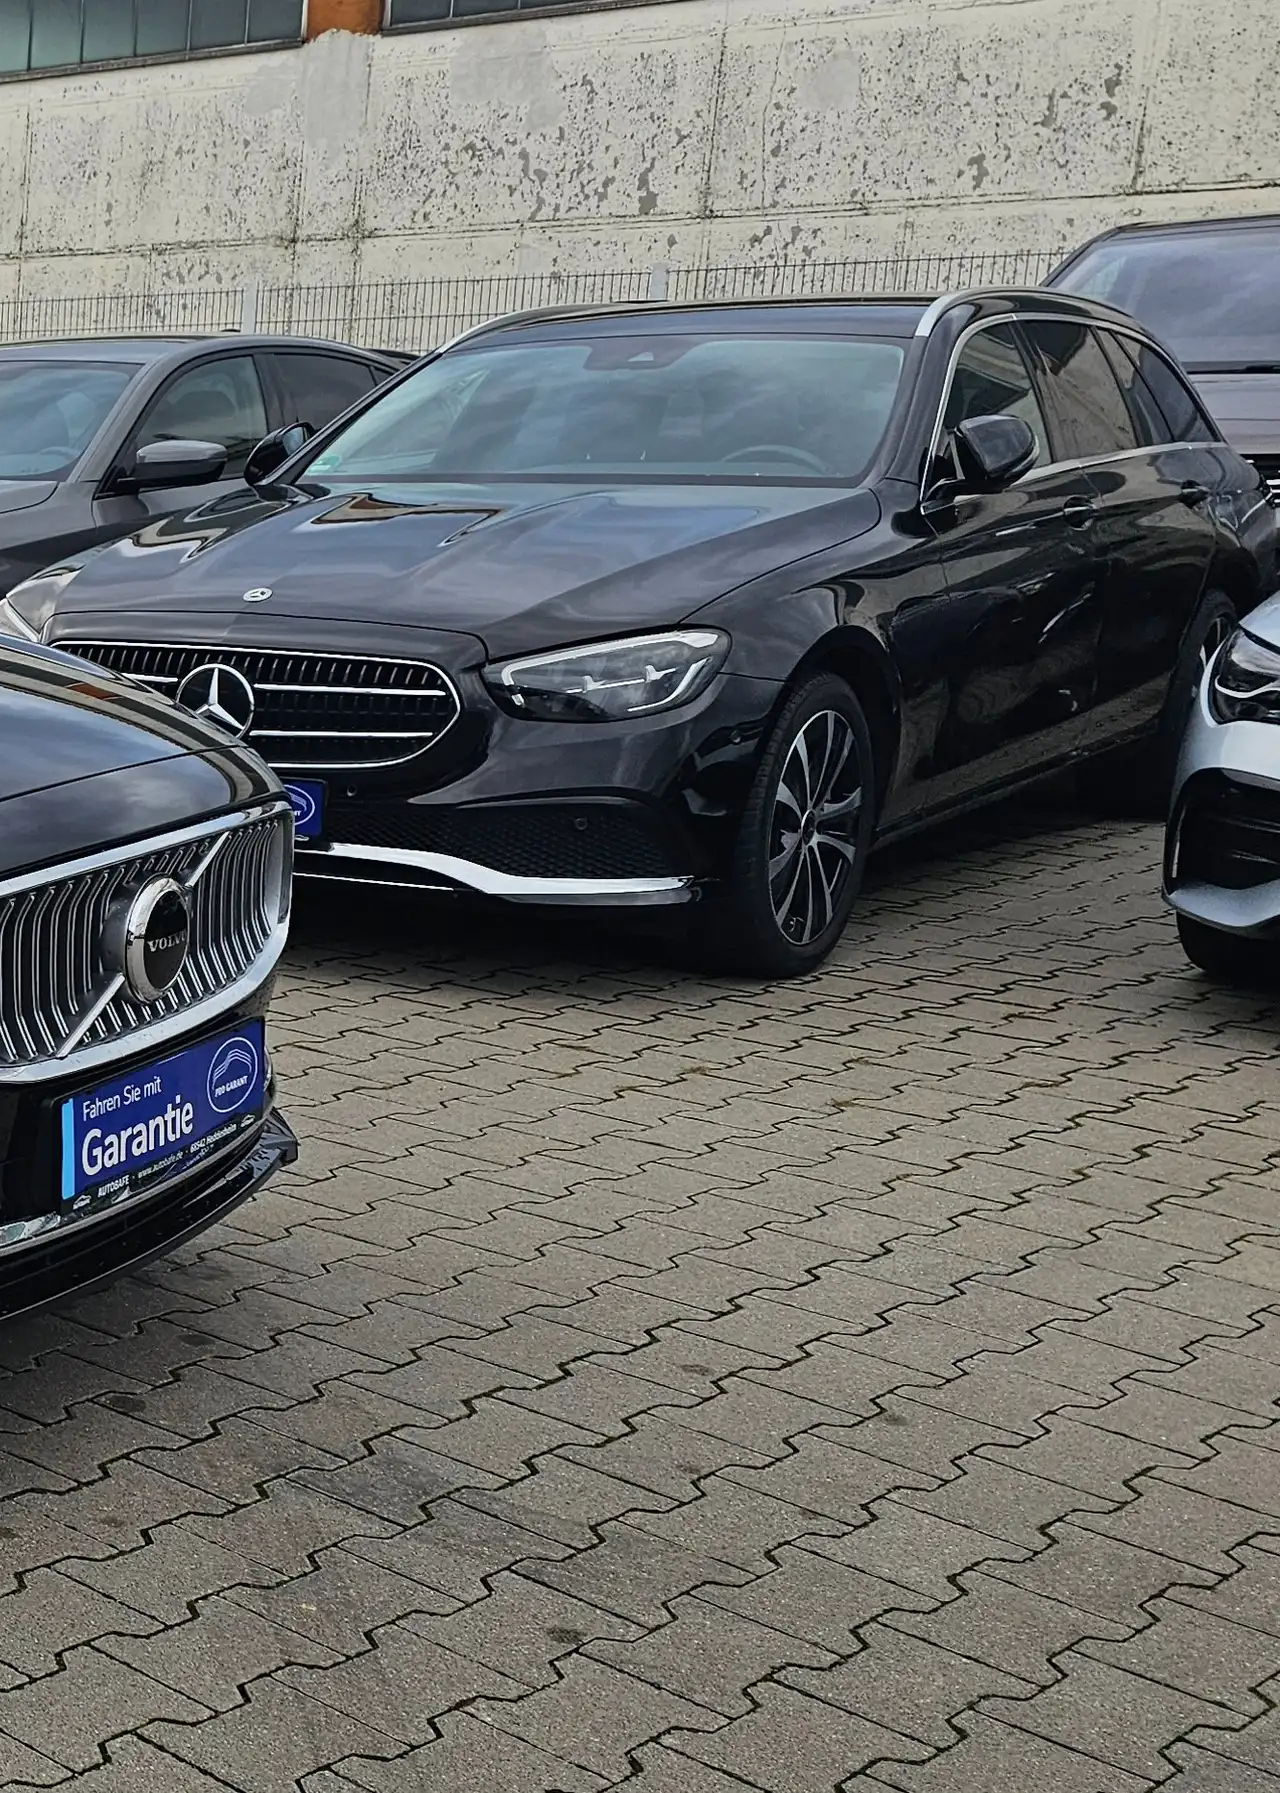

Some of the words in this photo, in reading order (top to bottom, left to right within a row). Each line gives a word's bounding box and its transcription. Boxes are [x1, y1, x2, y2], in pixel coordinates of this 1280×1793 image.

[82, 1094, 121, 1122] Fahren
[123, 1084, 141, 1105] Sie
[143, 1075, 162, 1099] mit
[214, 1085, 226, 1098] PRO
[225, 1075, 248, 1092] GARANT
[81, 1094, 194, 1176] Garantie
